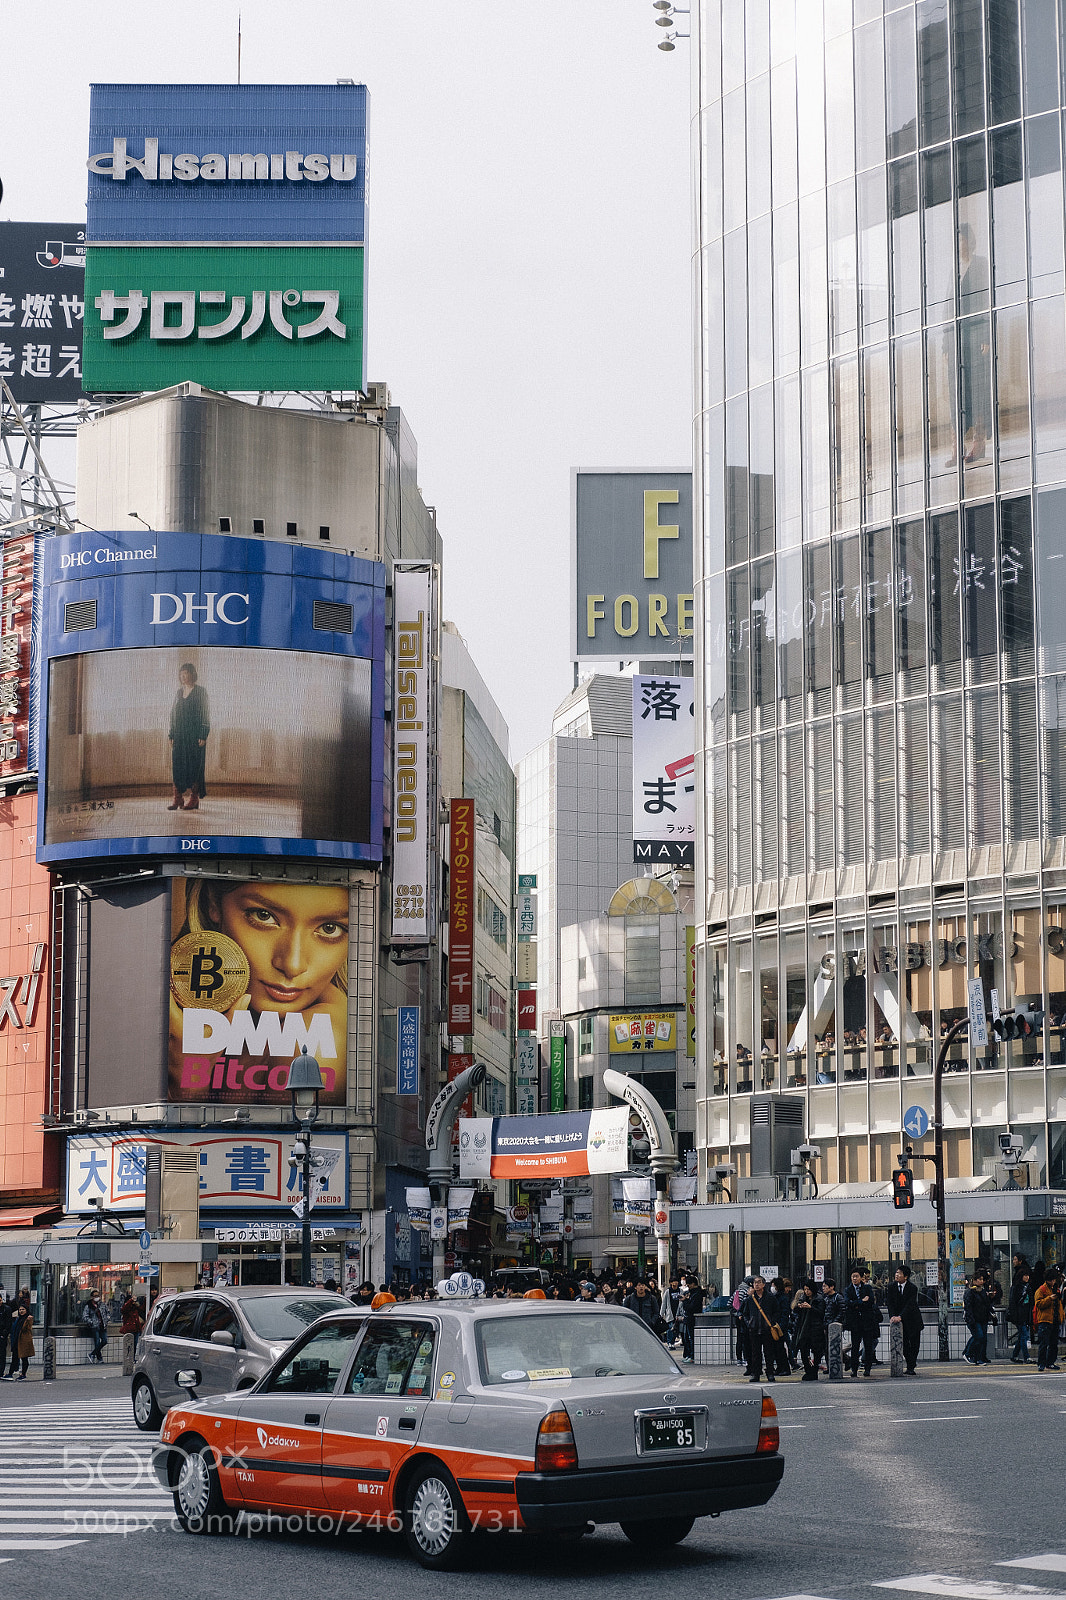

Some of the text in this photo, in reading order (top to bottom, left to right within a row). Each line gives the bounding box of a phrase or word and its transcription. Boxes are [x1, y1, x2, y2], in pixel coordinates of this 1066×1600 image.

[86, 137, 357, 181] Hisamitsu
[94, 289, 347, 340] サロンパス
[643, 489, 680, 579] F
[60, 545, 158, 569] DHC Channel
[149, 592, 249, 625] DHC
[640, 681, 695, 721] 落
[397, 610, 424, 843] Taisei neon
[643, 777, 695, 815] ま
[181, 839, 211, 852] DHC
[453, 804, 469, 933] クスリのことなら
[820, 932, 1018, 981] STARBUCKS
[450, 943, 472, 1024] 三千里
[519, 1005, 536, 1015] JTB
[182, 1007, 338, 1059] DMM
[180, 1056, 336, 1092] Bitcon
[515, 1158, 540, 1166] Welcome
[546, 1156, 568, 1165] SHIBUYA
[287, 1195, 342, 1204] BOO AISEIDO
[268, 1436, 300, 1448] odakyu
[237, 1471, 255, 1482] TAXI
[369, 1485, 384, 1496] 277
